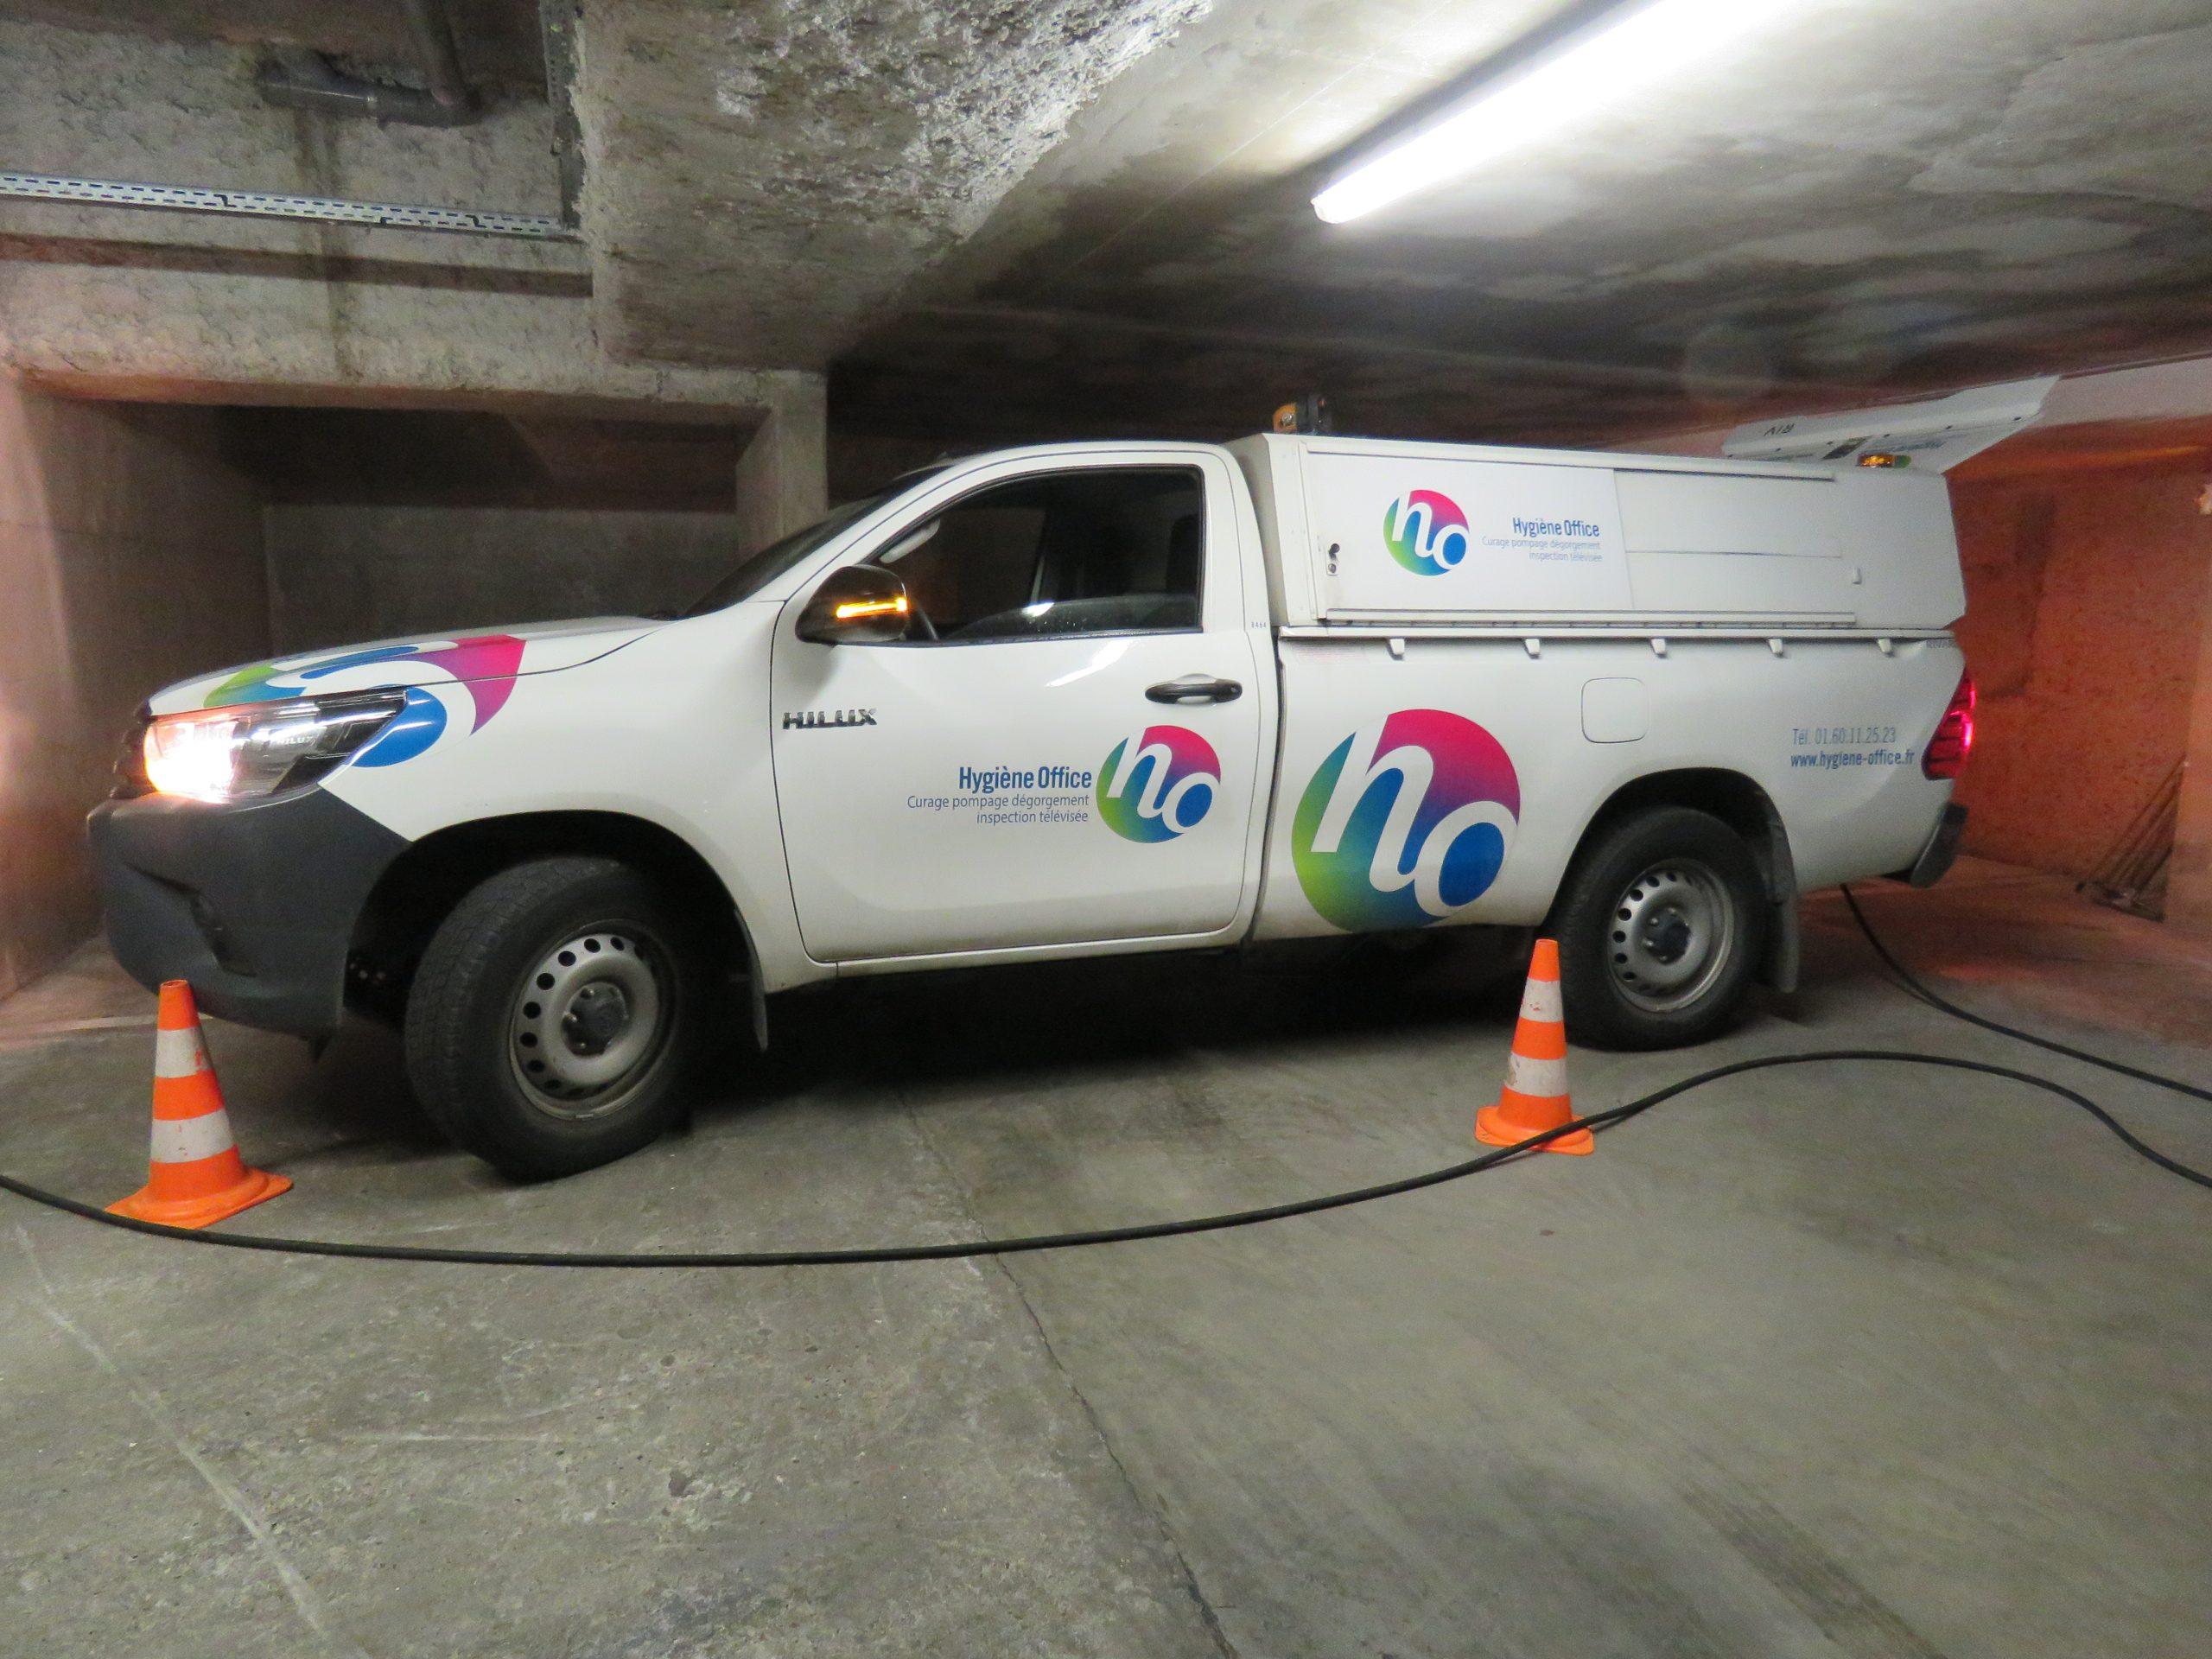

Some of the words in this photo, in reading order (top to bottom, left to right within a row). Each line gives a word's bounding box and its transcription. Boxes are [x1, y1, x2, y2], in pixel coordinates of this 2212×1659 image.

[1512, 517, 1562, 537] Hygiène
[1563, 519, 1600, 537] Office
[1482, 536, 1510, 550] Curage
[1511, 538, 1548, 550] pompage
[1550, 538, 1601, 550] dégorgement
[1529, 552, 1568, 563] inspection
[783, 708, 878, 730] HILUX
[1815, 727, 1896, 745] 01.60.11.25.23
[1790, 748, 1916, 770] www.hygiene-office.fr
[958, 766, 1034, 794] Hygiène
[1038, 766, 1092, 789] Office
[906, 795, 950, 810] Curage
[951, 796, 1009, 810] pompage
[1011, 794, 1090, 810] dégorgement
[976, 810, 1037, 826] inspection
[1039, 810, 1089, 823] télévisée
